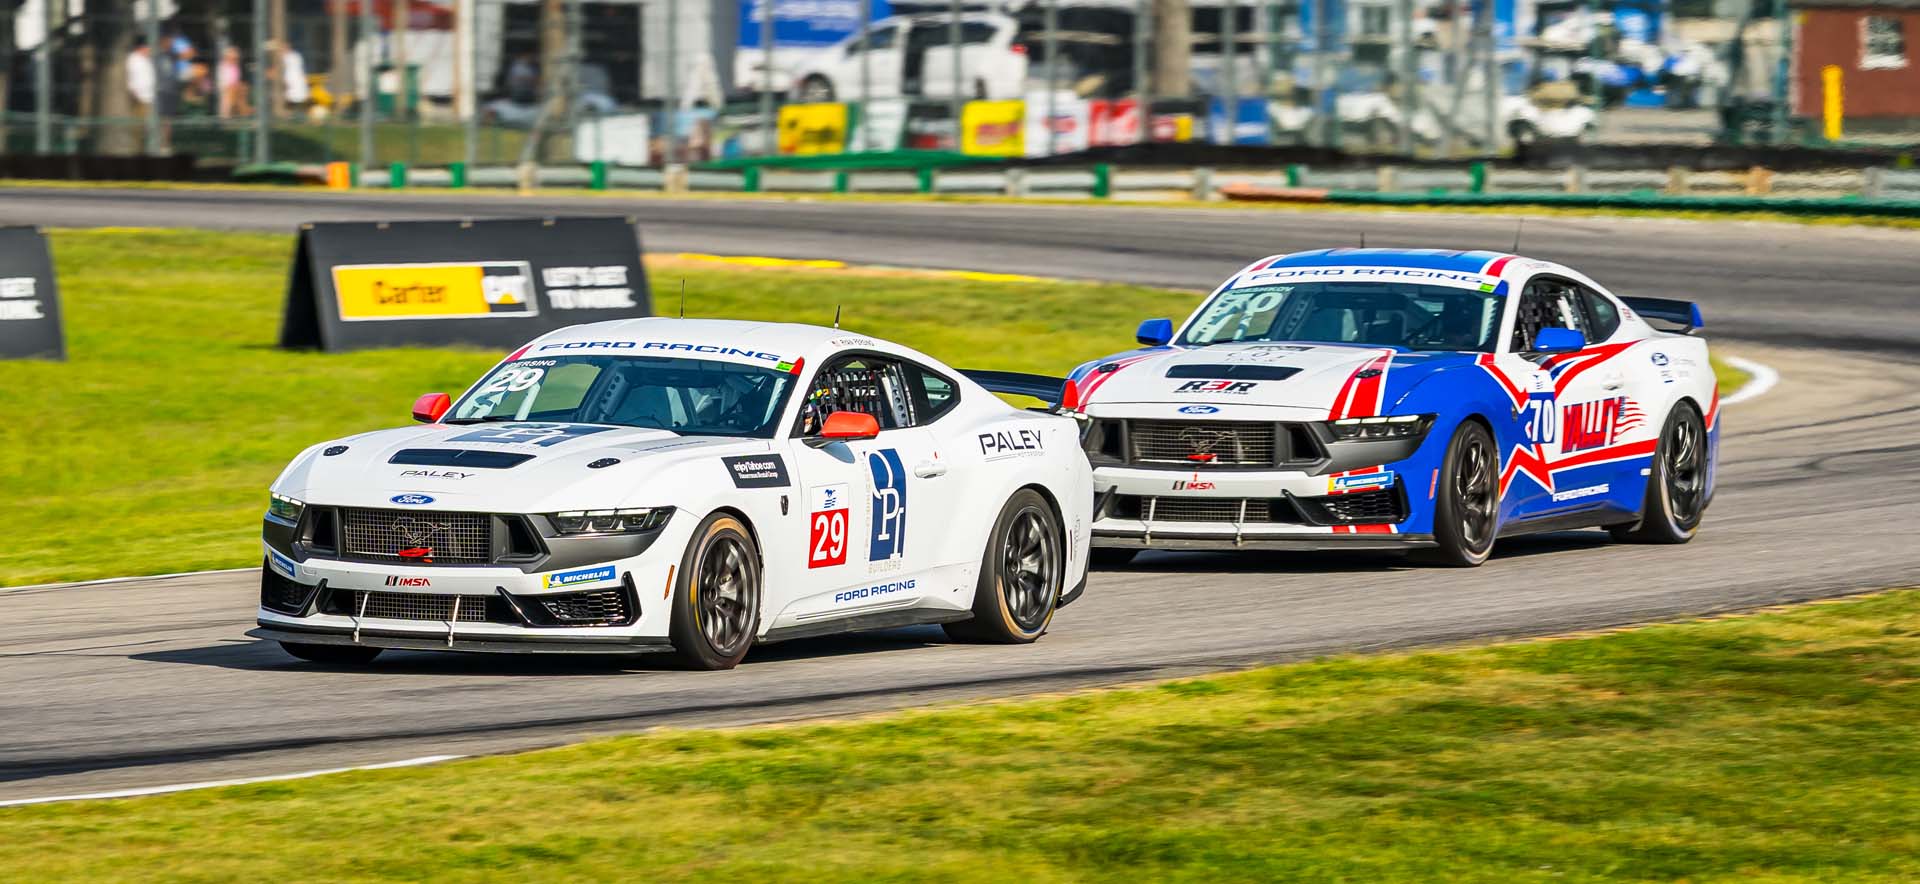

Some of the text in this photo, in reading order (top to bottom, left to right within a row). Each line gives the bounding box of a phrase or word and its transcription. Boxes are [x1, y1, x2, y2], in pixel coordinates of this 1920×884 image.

[1251, 268, 1484, 284] FORD RACING
[372, 281, 446, 306] Carter
[539, 341, 781, 362] FORD RACING
[509, 359, 557, 368] PERSING
[484, 367, 544, 392] 29
[1177, 380, 1259, 392] R3R
[1529, 399, 1555, 443] 70
[978, 429, 1044, 455] PALEY
[400, 470, 475, 479] PALEY
[1185, 481, 1216, 490] IMSA
[396, 494, 429, 505] Ford
[812, 511, 845, 562] 29
[398, 576, 431, 587] IMSA
[563, 570, 611, 583] MICHELIN
[835, 579, 916, 603] FORD RACING
